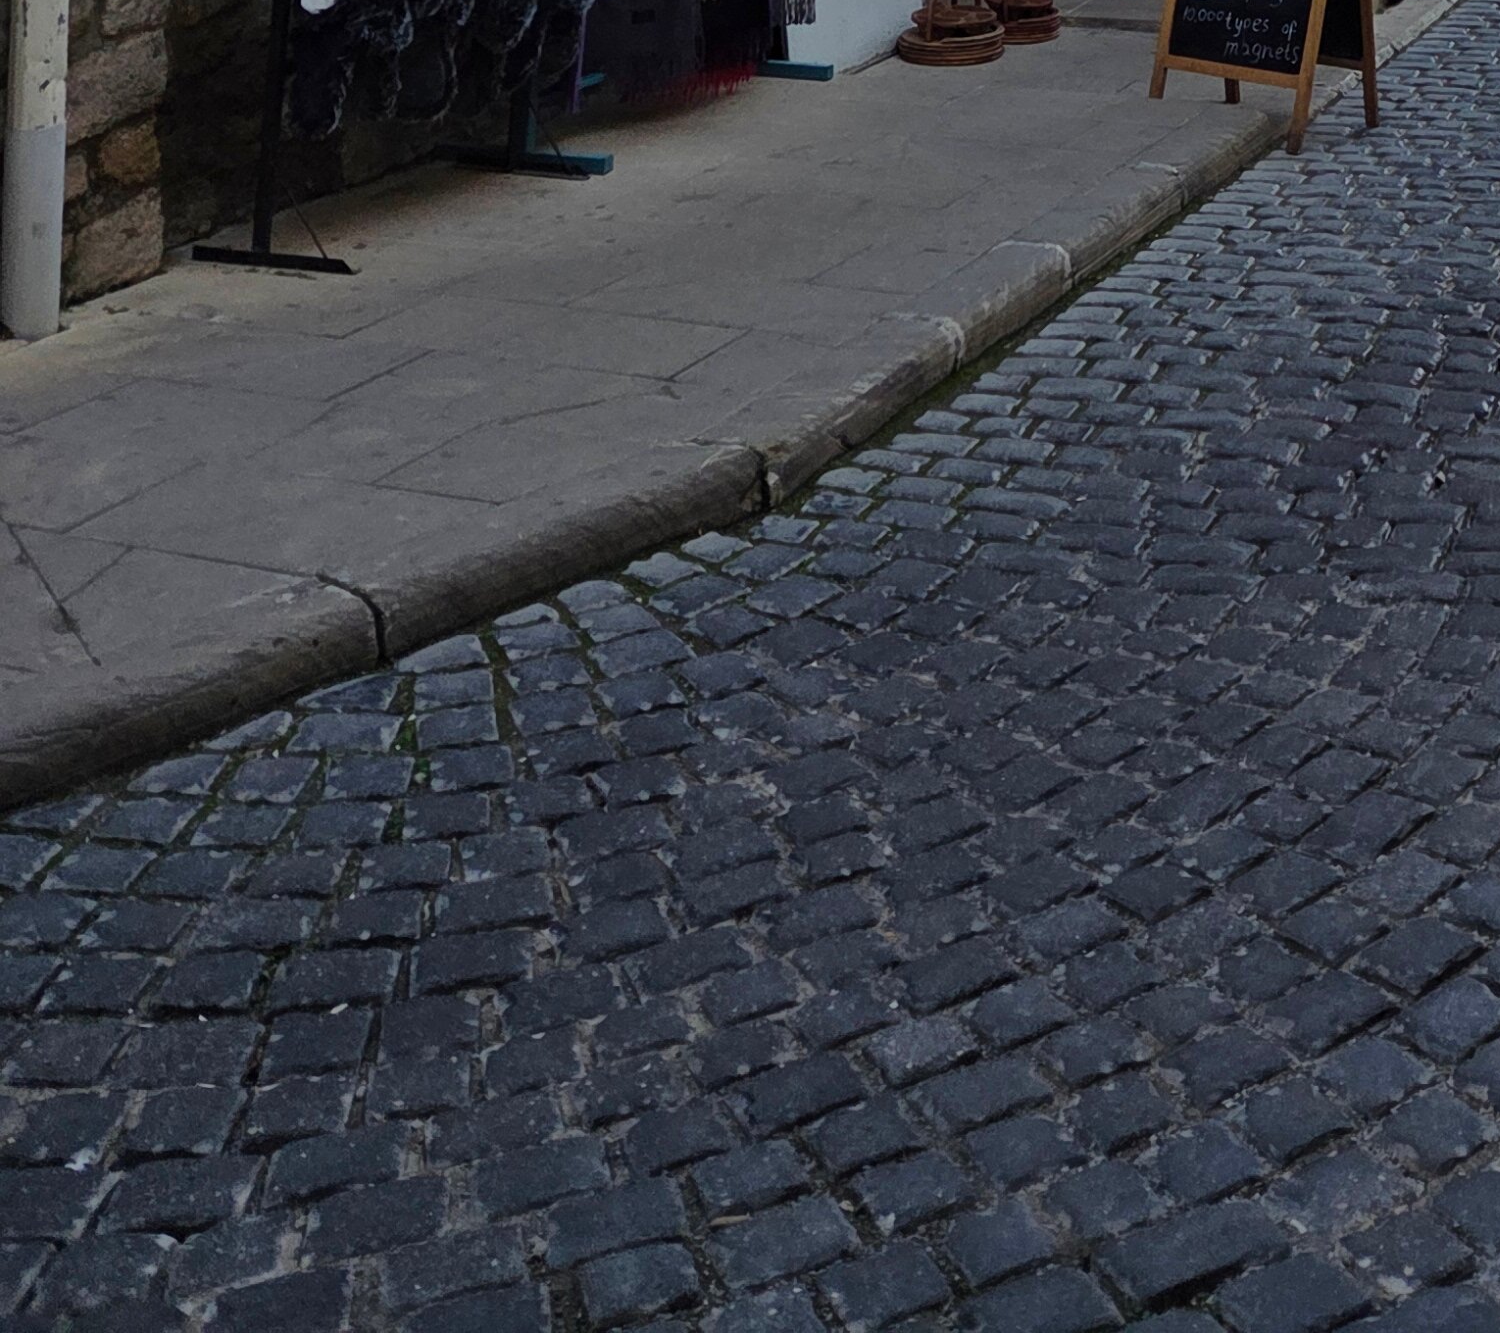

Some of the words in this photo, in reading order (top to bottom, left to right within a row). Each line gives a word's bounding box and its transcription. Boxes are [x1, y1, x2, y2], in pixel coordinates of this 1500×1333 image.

[1225, 12, 1269, 37] types
[1281, 20, 1298, 41] of
[1223, 40, 1300, 65] magnets
